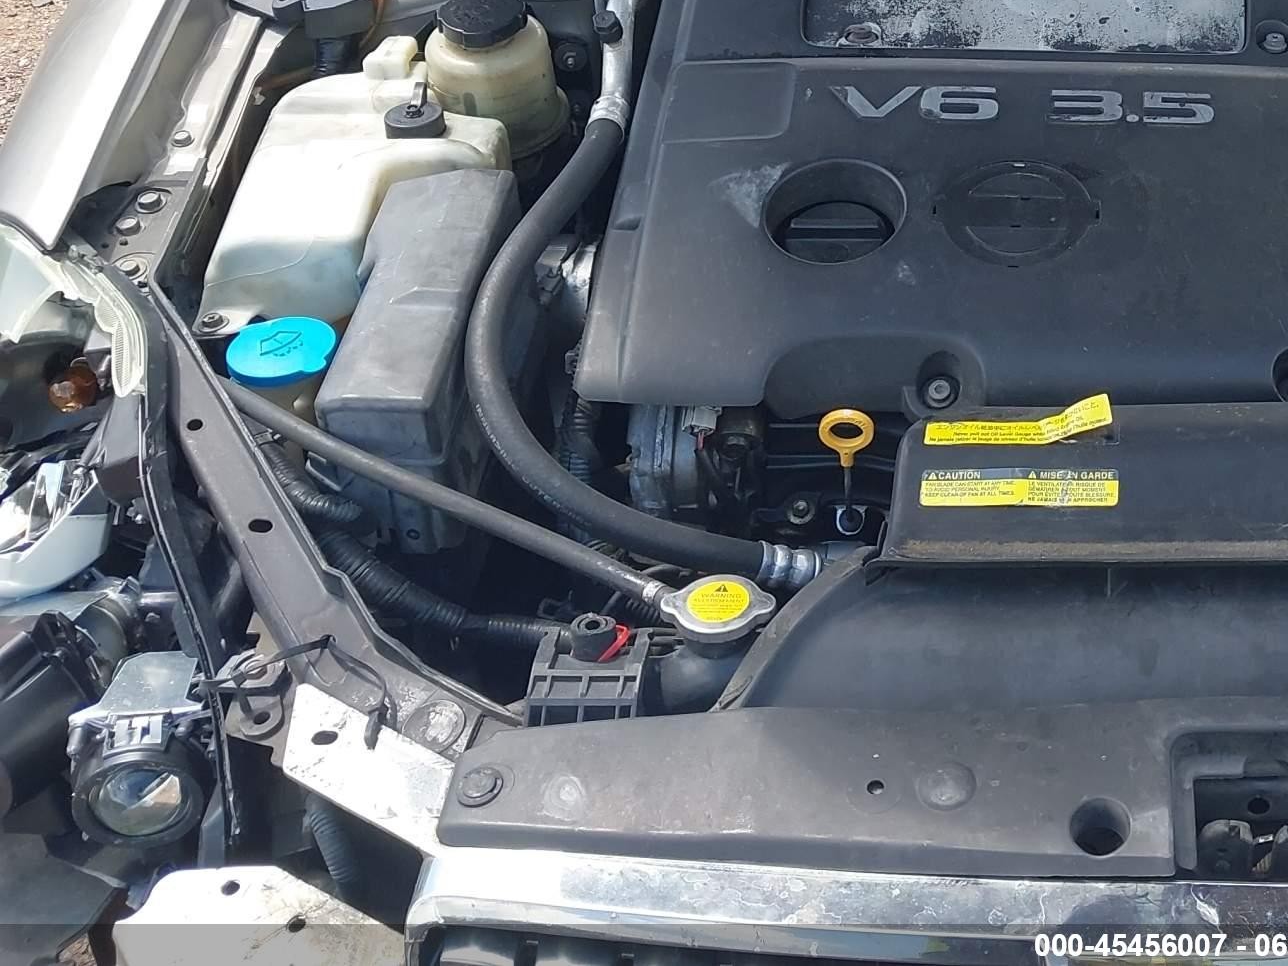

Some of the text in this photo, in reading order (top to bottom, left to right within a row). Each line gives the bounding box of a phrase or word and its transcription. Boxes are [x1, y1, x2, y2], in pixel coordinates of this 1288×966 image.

[828, 85, 1215, 124] V6 3.5
[938, 471, 980, 480] CAUTION
[1040, 471, 1063, 480] MISE
[1080, 471, 1114, 480] GARDE
